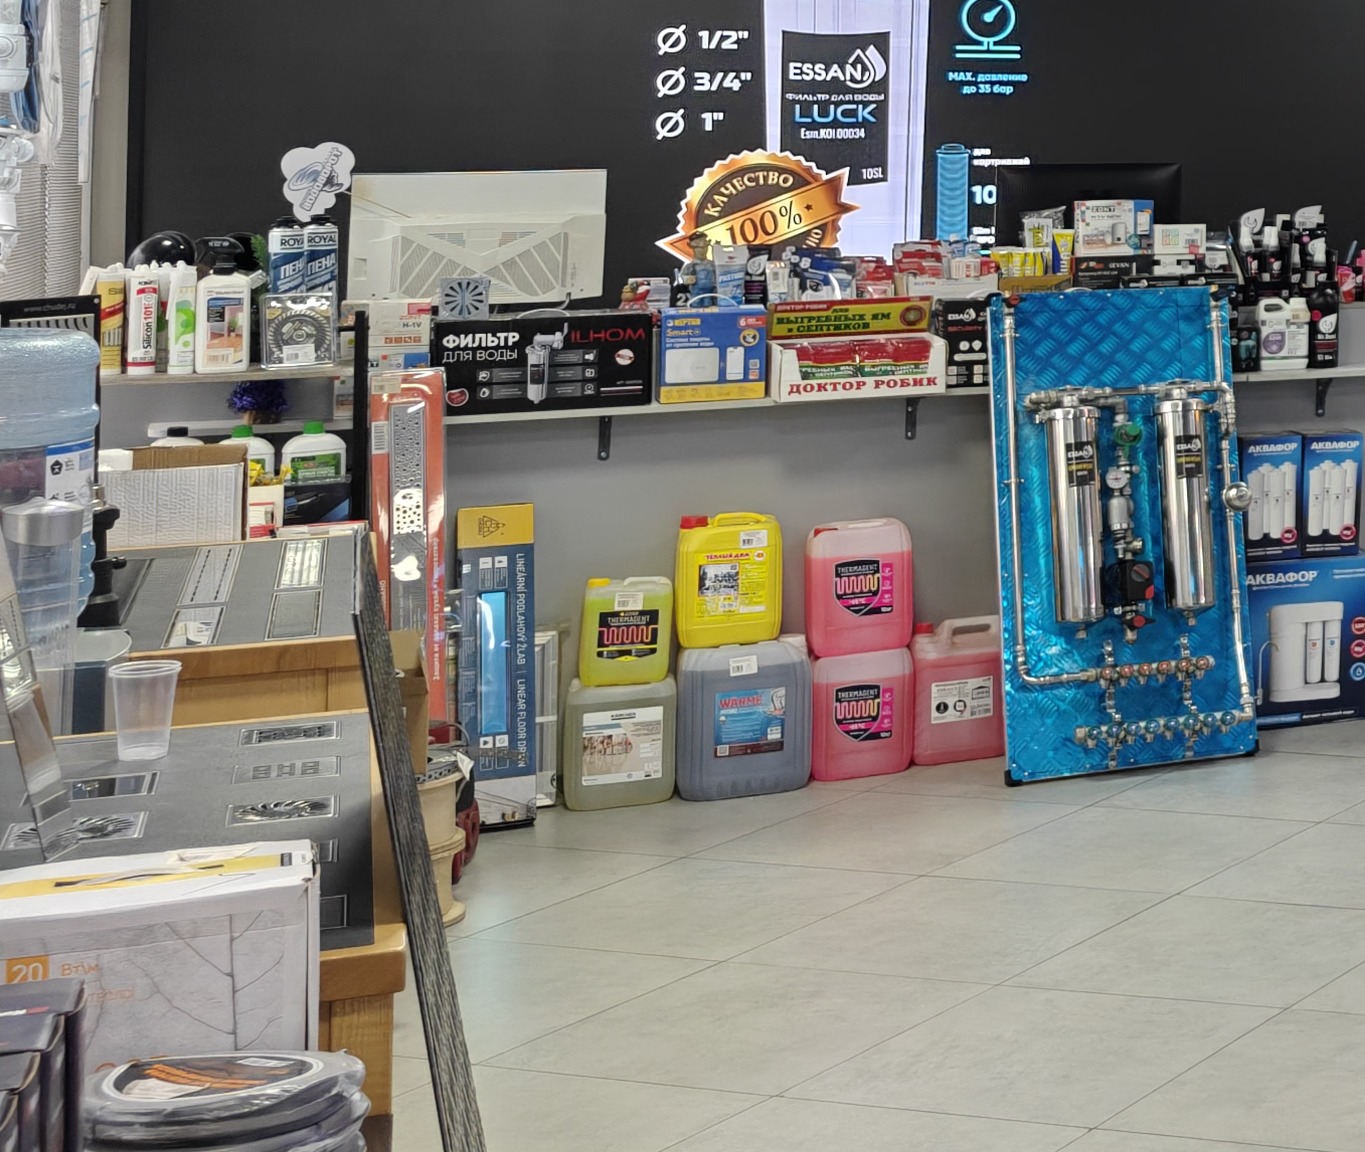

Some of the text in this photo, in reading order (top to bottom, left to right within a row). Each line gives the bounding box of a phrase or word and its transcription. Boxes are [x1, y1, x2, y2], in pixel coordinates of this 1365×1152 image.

[698, 30, 749, 51] 1/2"
[693, 72, 754, 92] 3/4"
[788, 62, 862, 82] ESSAN
[794, 104, 877, 123] LUCK
[704, 171, 795, 217] КАЧЕСТВО
[726, 200, 803, 247] 100%
[307, 232, 337, 245] ROYAL
[308, 253, 337, 276] ПЕНА
[442, 332, 520, 348] ФИЛЬТР
[570, 328, 646, 344] ILHOM
[442, 349, 518, 363] ДЛЯ ВОДЫ
[788, 377, 938, 397] ДОКТОР РОБИК
[1249, 442, 1299, 454] АКВАФОР
[1310, 440, 1360, 451] АКВАФОР
[1246, 570, 1319, 587] АКВАФОР
[516, 679, 527, 710] LINEAR
[516, 711, 527, 739] FLOOR
